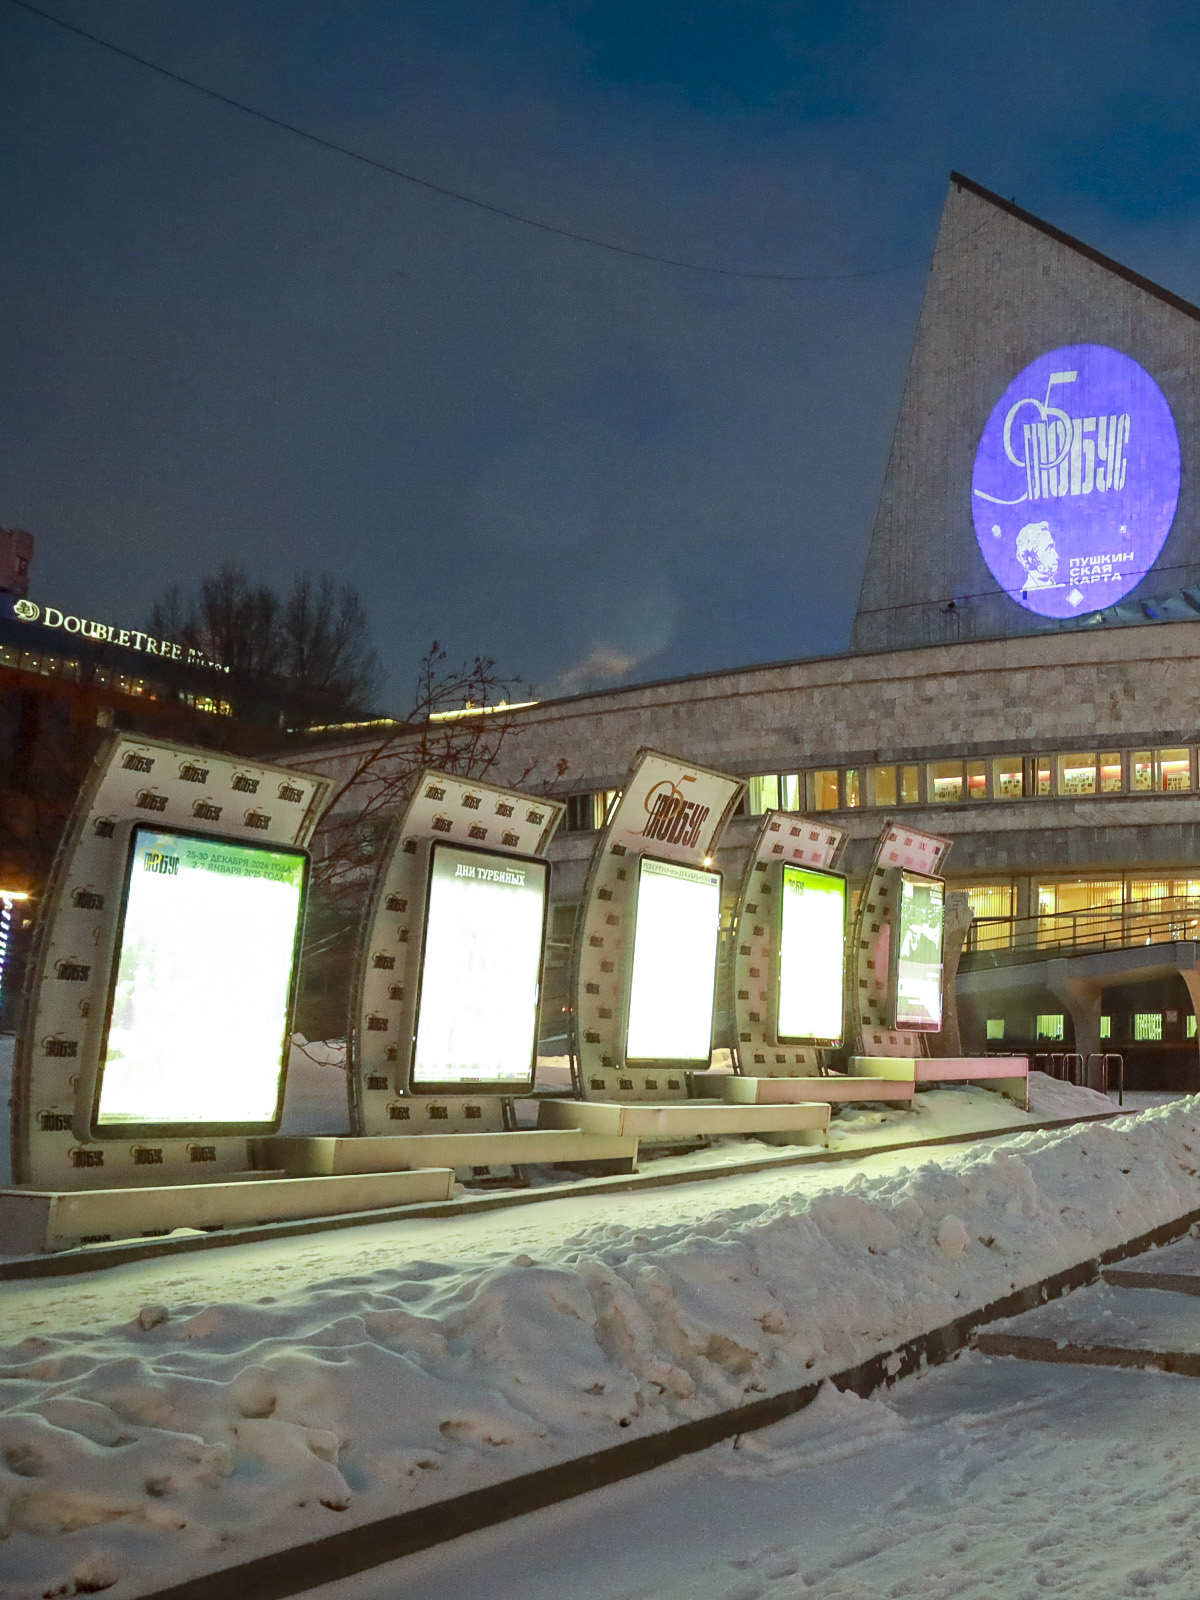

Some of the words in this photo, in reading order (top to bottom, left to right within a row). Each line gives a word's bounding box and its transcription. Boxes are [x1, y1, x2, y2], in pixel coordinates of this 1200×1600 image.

[1069, 552, 1134, 567] ПУШКИН
[1069, 564, 1112, 577] СКАЯ
[1069, 573, 1122, 585] КАРТА
[43, 607, 182, 660] DOUBLETREE
[186, 850, 208, 860] 25-30
[210, 854, 249, 867] ДЕКАБРЯ
[251, 860, 269, 869] 2024
[271, 863, 291, 873] ГОДА
[207, 864, 242, 876] ЯНВАРЯ
[263, 871, 284, 881] ГОДА
[455, 863, 476, 878] ДНИ
[477, 867, 525, 886] ТУРБИНЫХ
